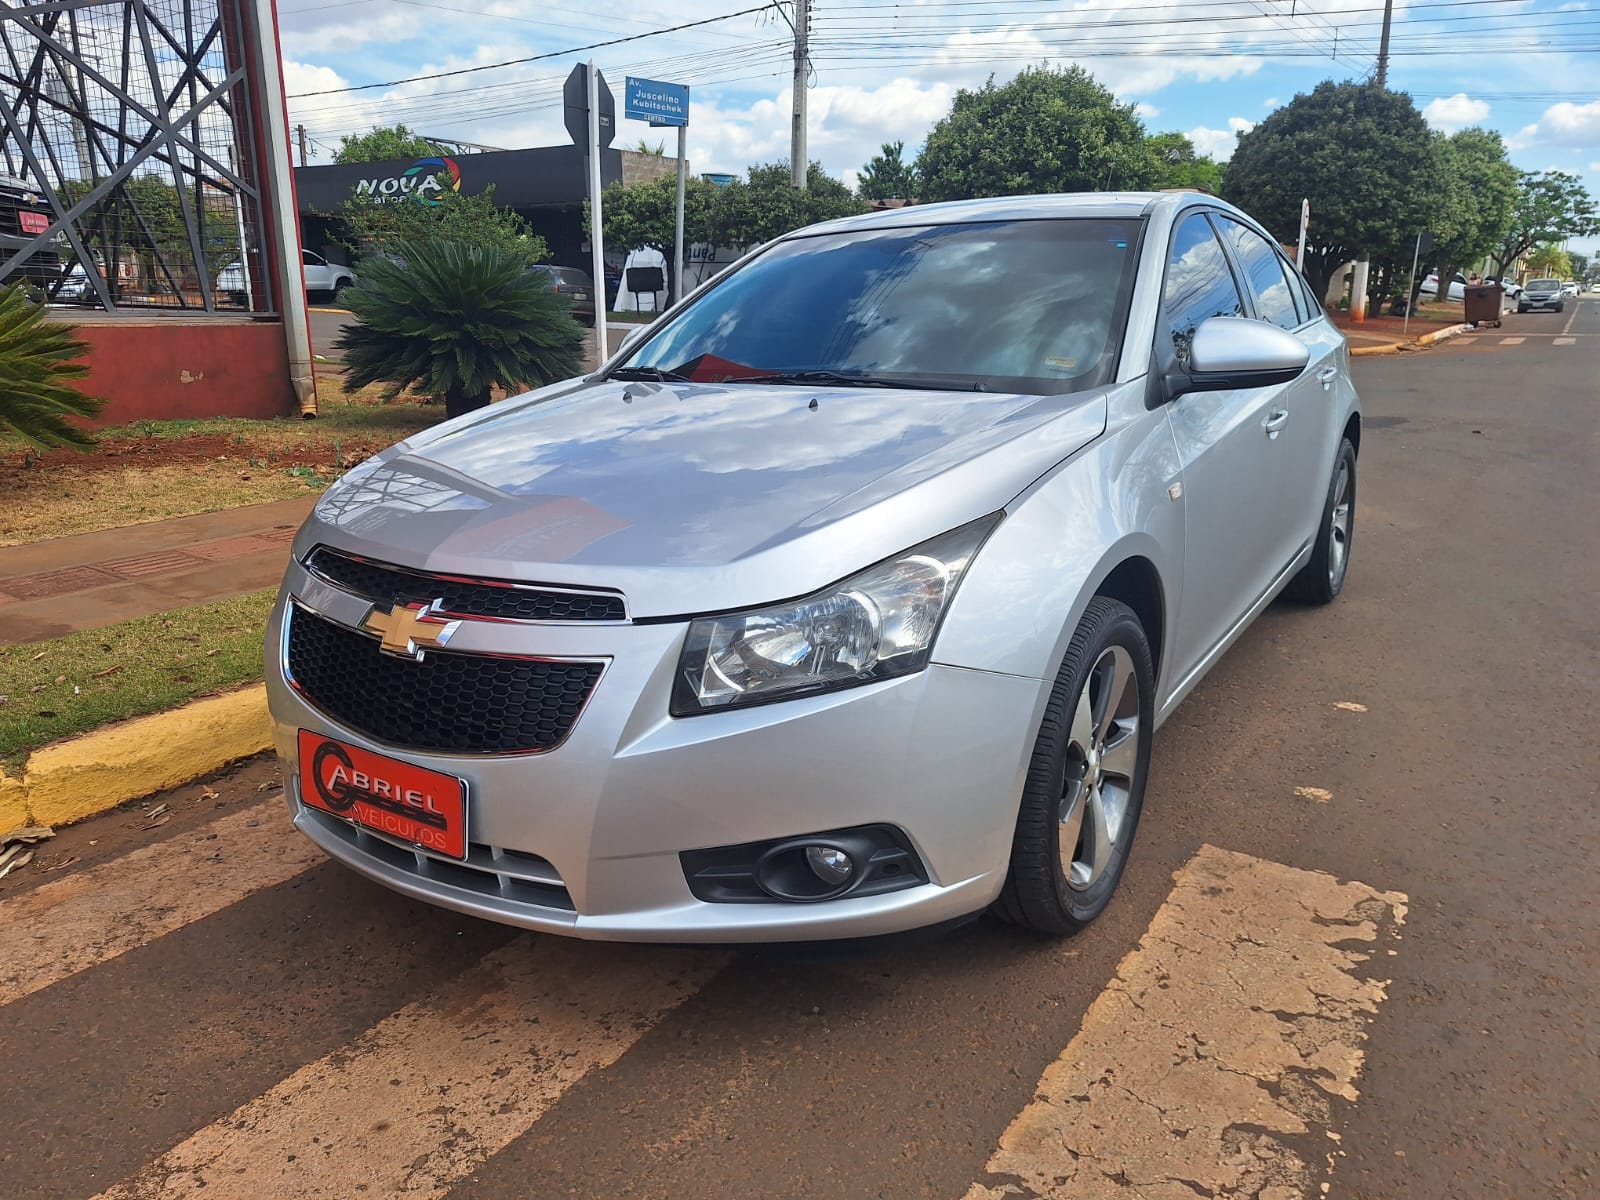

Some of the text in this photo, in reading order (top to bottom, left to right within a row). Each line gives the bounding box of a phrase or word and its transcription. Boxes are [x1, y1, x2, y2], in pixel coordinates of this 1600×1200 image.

[629, 79, 642, 87] Av.
[636, 90, 680, 104] Juscelino
[632, 98, 682, 113] Kubitschek
[356, 174, 443, 195] NOVA
[313, 741, 446, 818] GABRIEL
